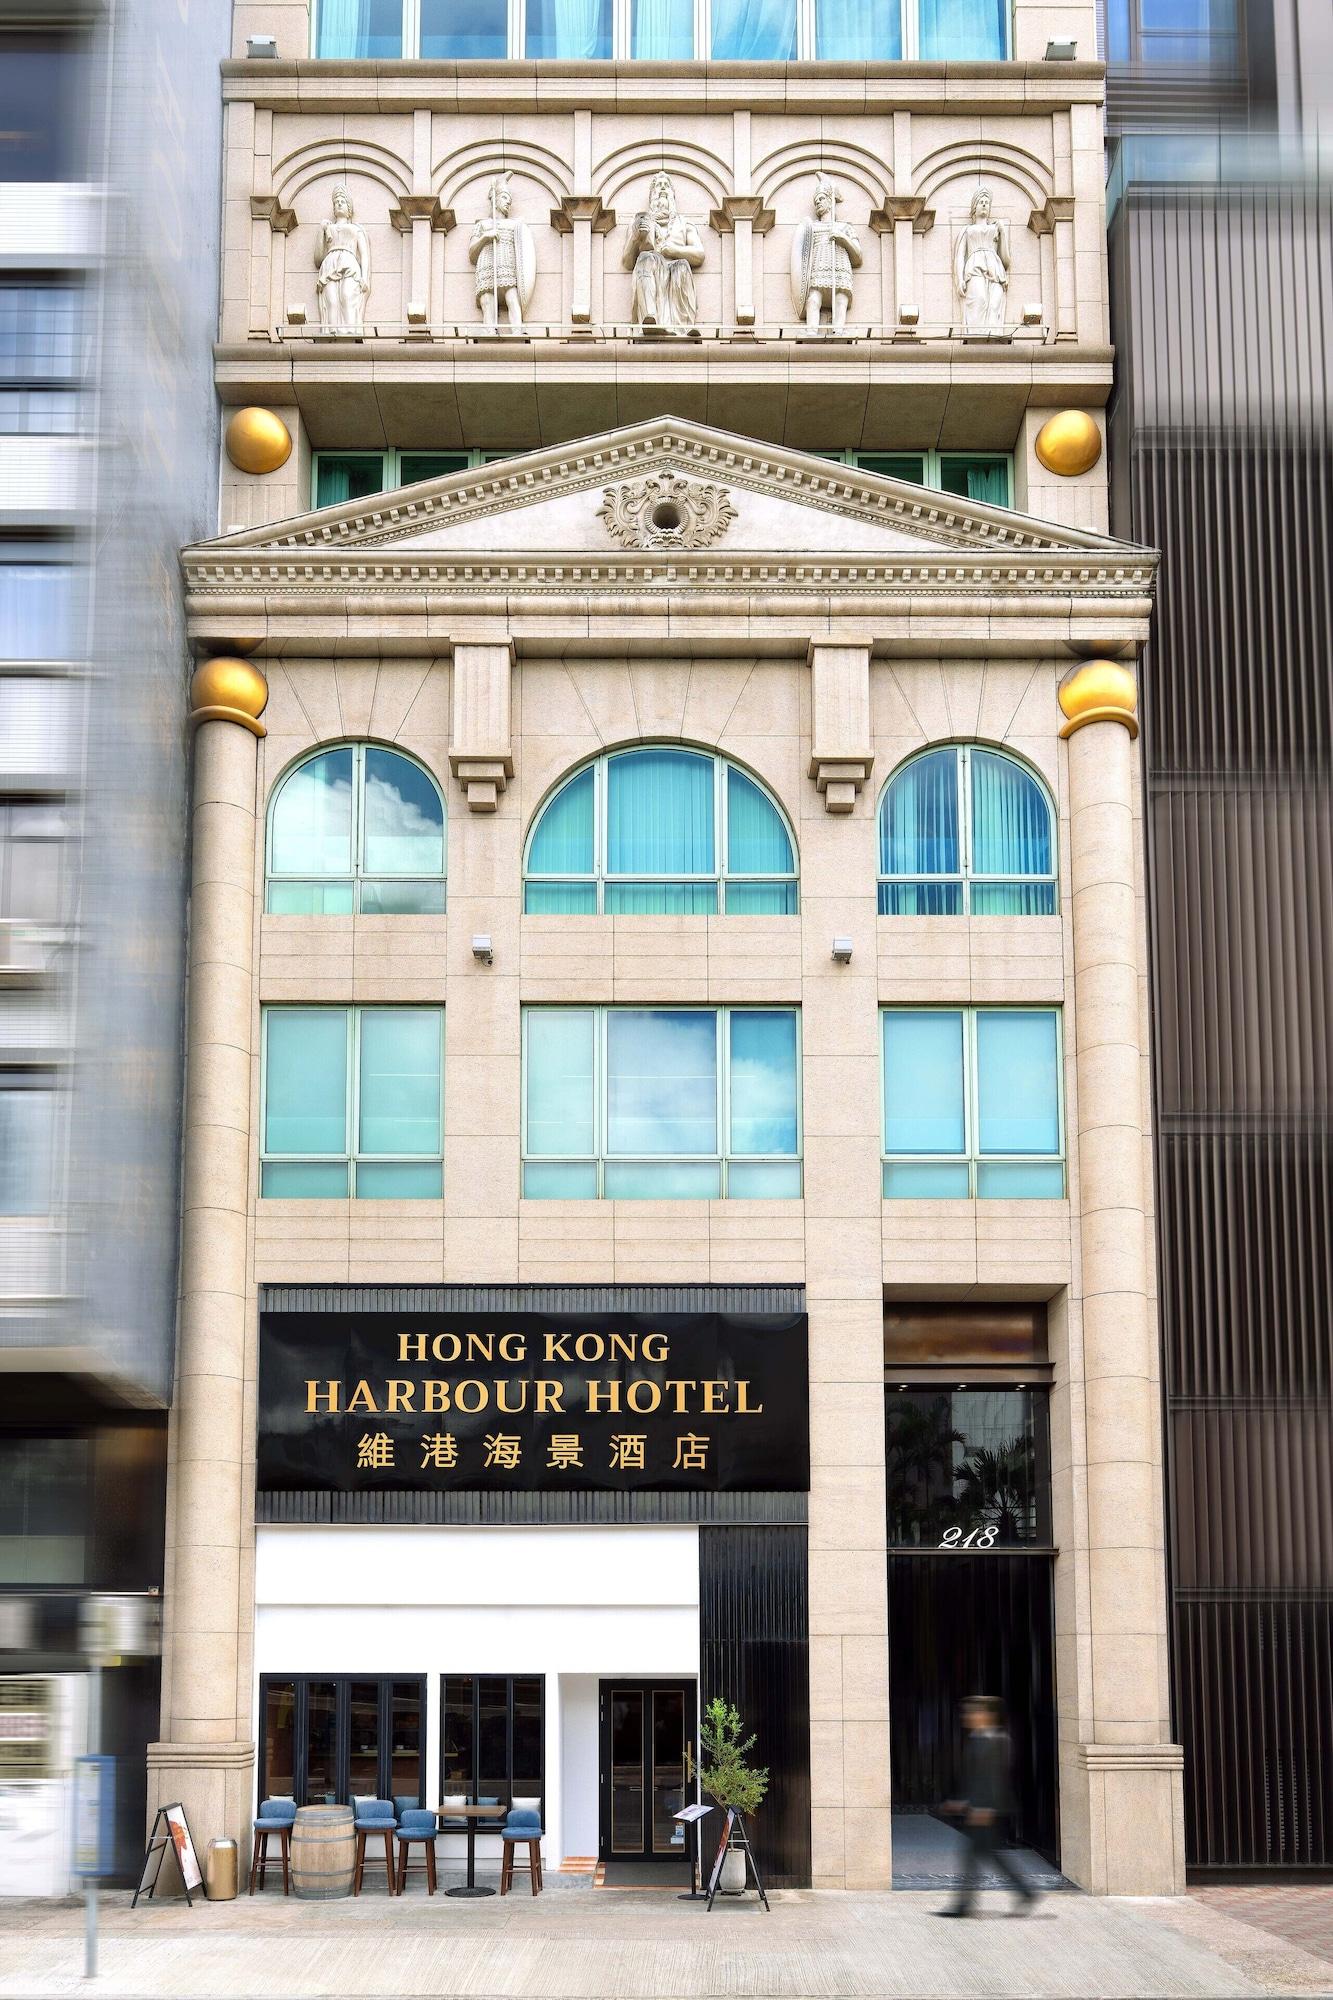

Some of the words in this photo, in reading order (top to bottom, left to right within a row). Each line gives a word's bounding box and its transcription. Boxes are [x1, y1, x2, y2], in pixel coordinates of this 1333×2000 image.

[396, 1333, 527, 1361] HONG
[542, 1333, 670, 1361] KONG
[303, 1380, 567, 1413] HARBOUR
[585, 1380, 763, 1413] HOTEL
[356, 1432, 711, 1469] 維港海景酒店
[938, 1526, 999, 1549] 218
